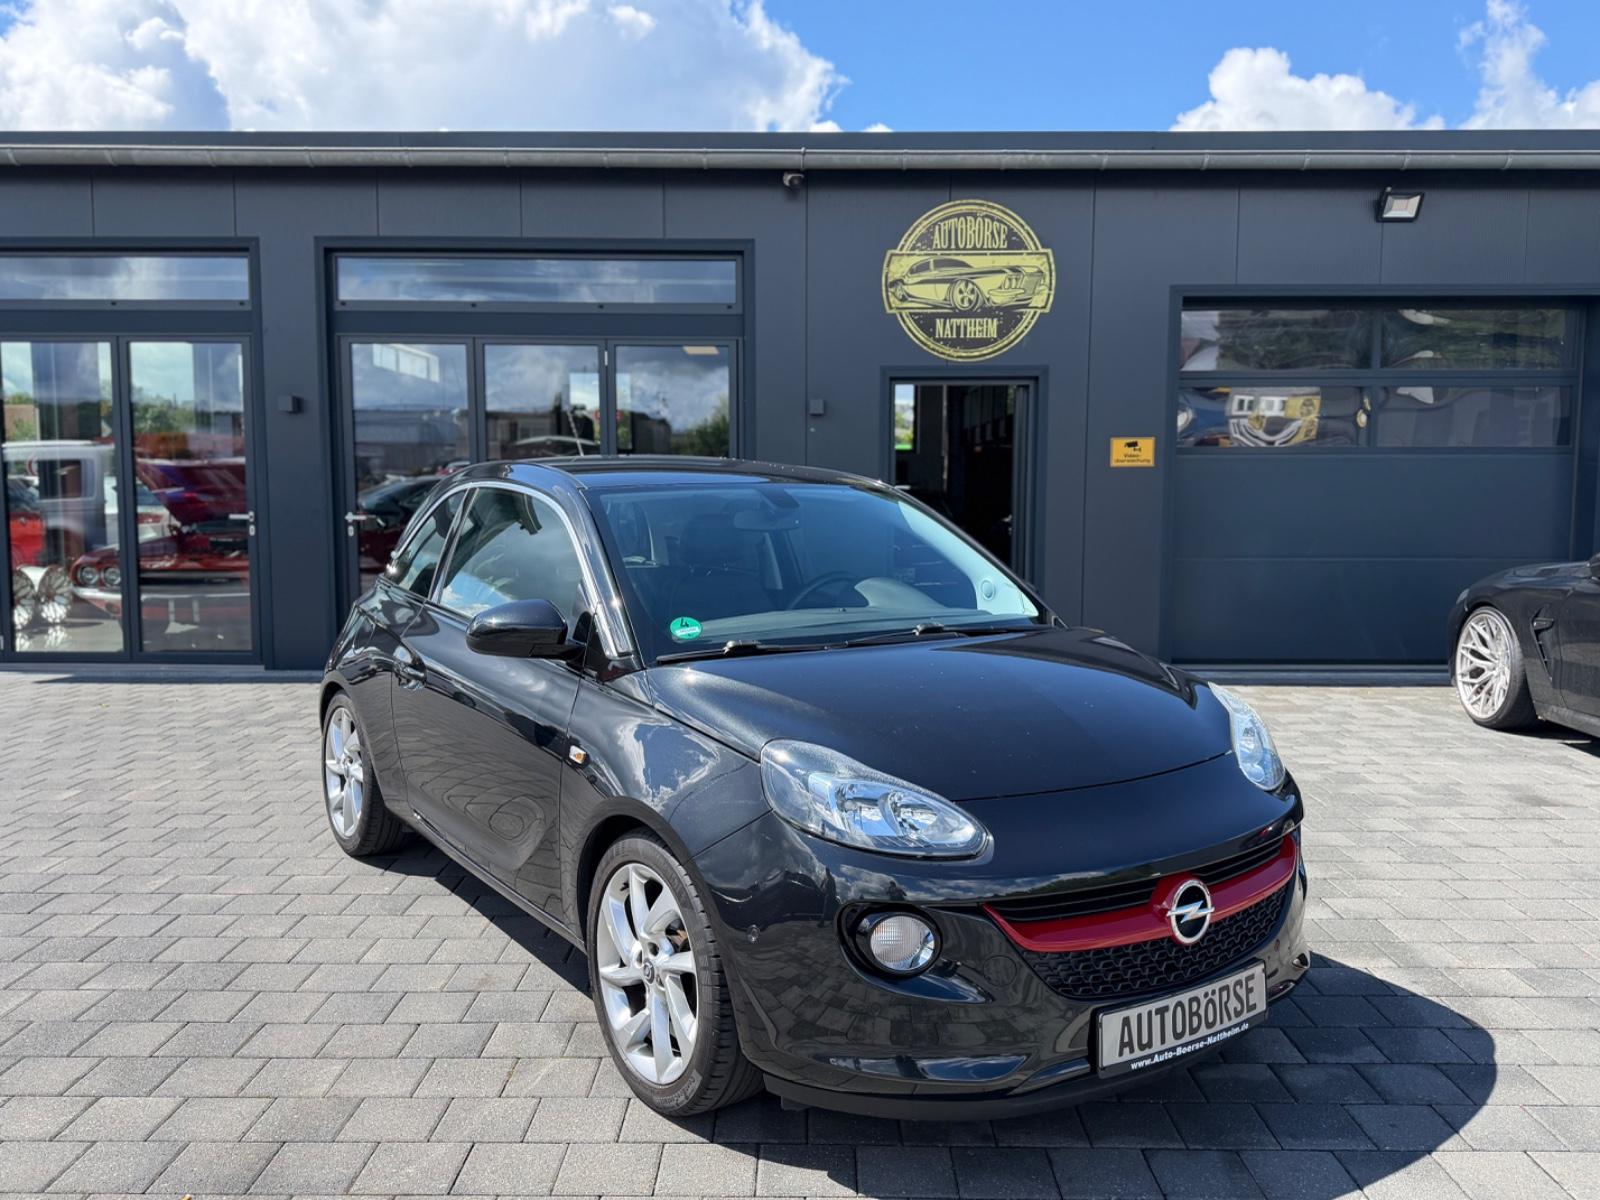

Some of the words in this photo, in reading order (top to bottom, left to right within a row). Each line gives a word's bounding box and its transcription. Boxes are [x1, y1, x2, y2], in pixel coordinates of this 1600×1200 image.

[934, 213, 1008, 249] AUTOBÖRSE
[935, 317, 998, 338] NATTHEIM
[680, 617, 690, 628] 4
[1119, 974, 1257, 1057] AUTOBÖRSE
[1131, 1022, 1249, 1070] www.Auto-Boerse-Nattheim.de
